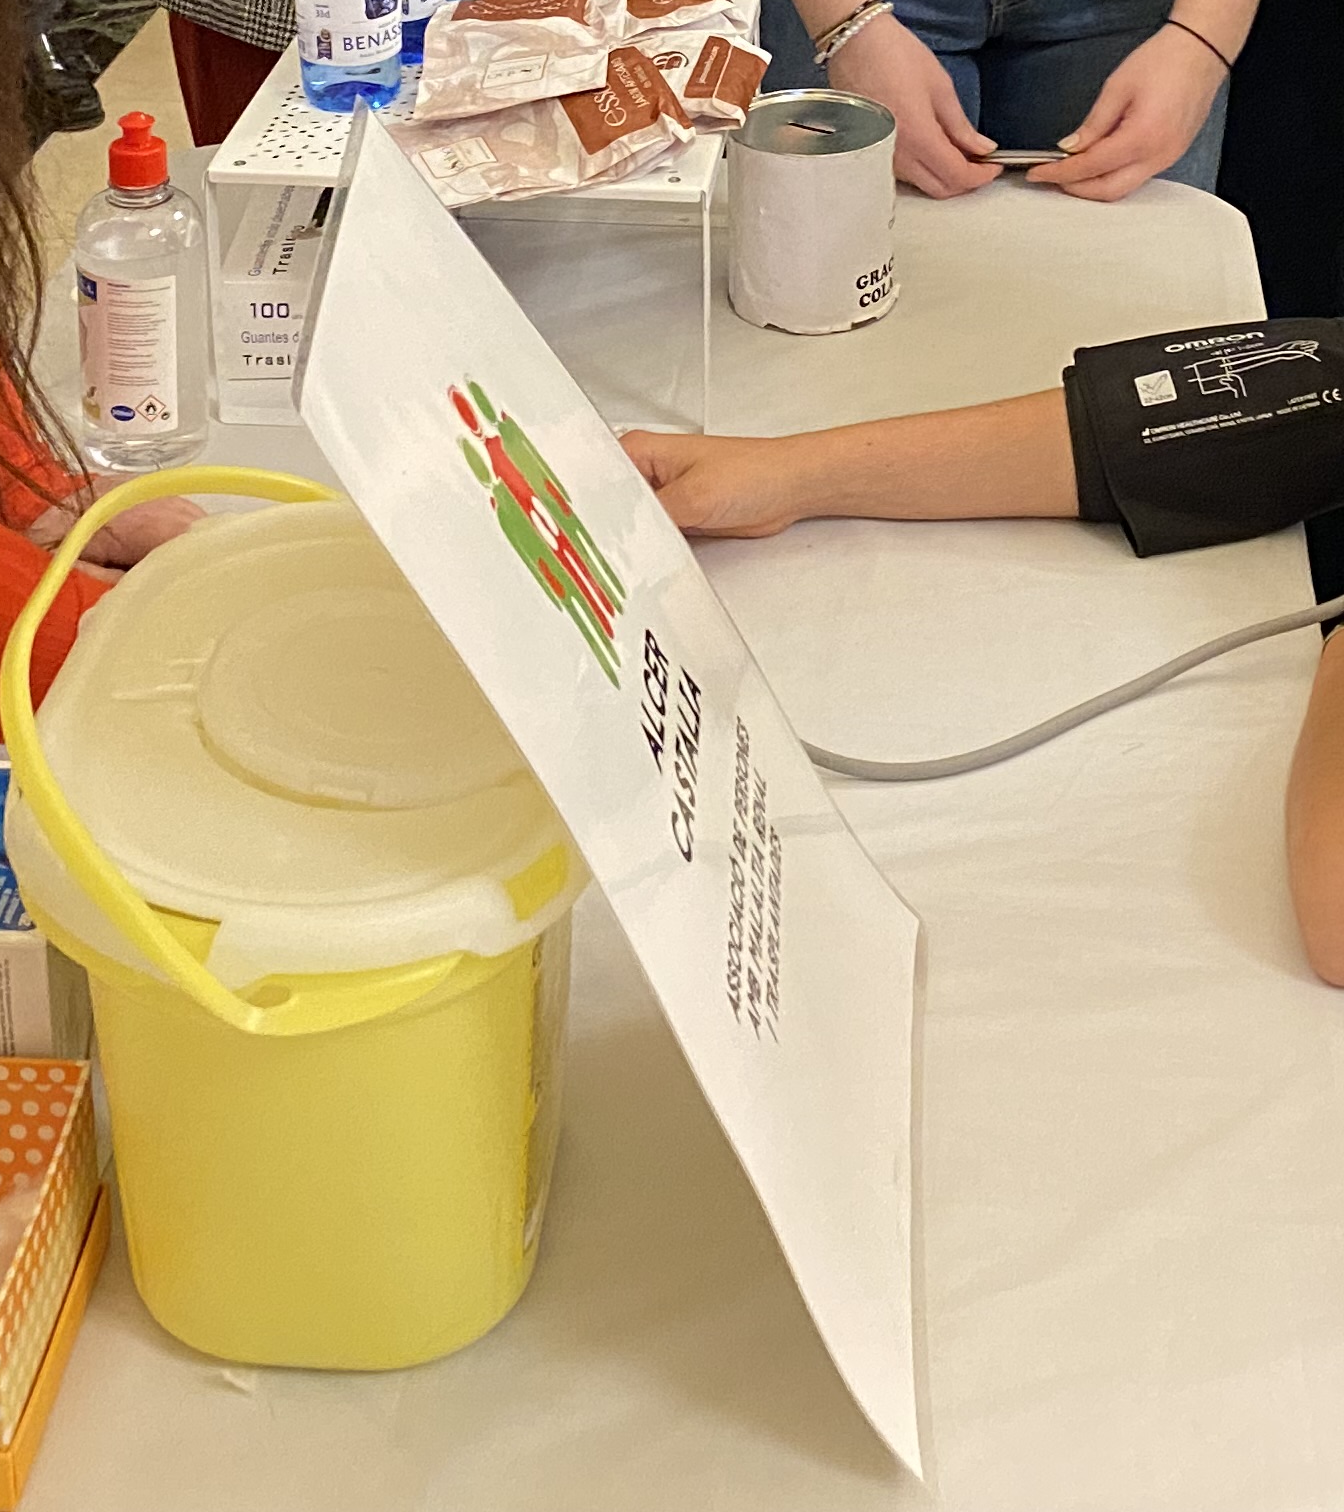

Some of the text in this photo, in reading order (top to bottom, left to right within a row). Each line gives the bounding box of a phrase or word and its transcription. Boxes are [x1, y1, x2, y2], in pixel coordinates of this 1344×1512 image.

[240, 330, 289, 344] Guantes
[249, 302, 290, 319] 100
[640, 628, 669, 777] ALCER
[671, 664, 702, 863] CASTALIA
[732, 714, 750, 829] PERSONES
[730, 816, 747, 863] DE
[746, 766, 767, 1041] AMB MALALTIA RENAL
